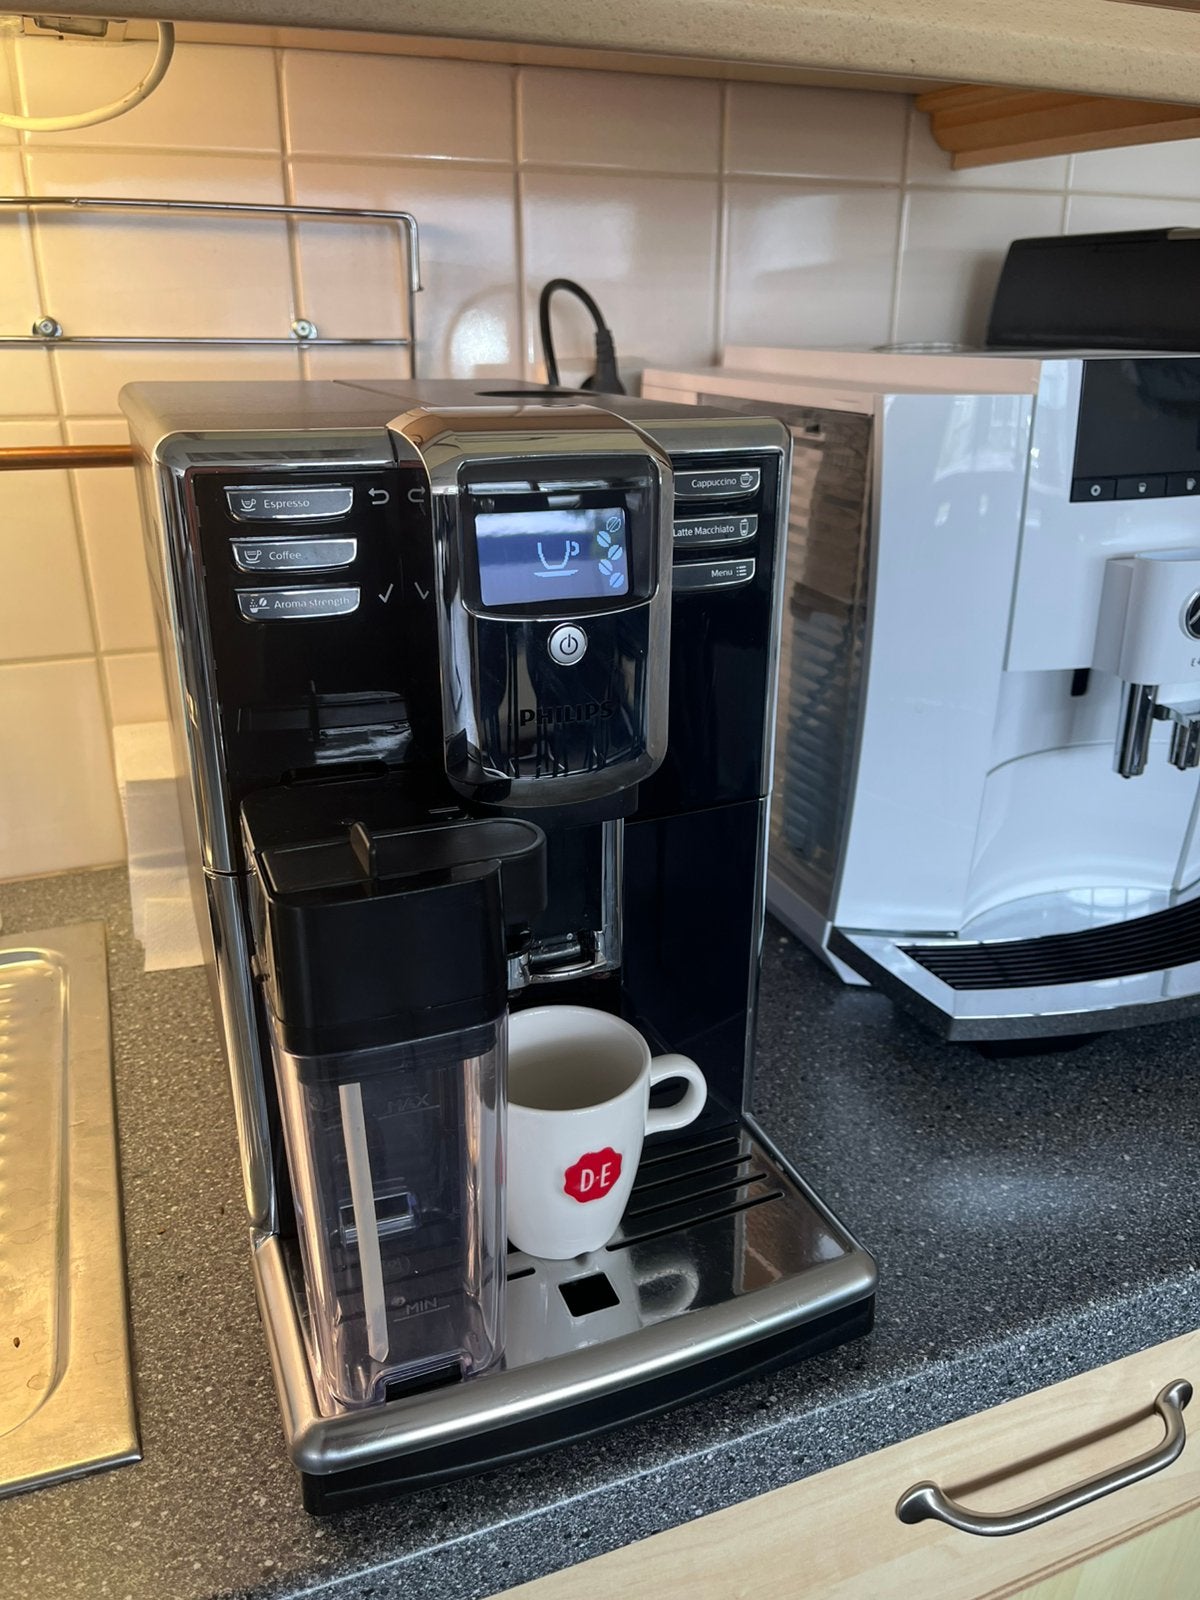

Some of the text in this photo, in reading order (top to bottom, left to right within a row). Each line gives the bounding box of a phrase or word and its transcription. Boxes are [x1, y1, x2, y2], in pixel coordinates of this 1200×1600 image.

[691, 477, 737, 489] Cappuccino
[263, 498, 310, 510] Espresso
[673, 524, 735, 537] Latte Macchiato
[268, 550, 302, 561] Coffee
[711, 568, 733, 578] Menu
[273, 595, 350, 610] Aroma strength
[519, 700, 617, 727] PHILIPS
[406, 1297, 438, 1315] MIN
